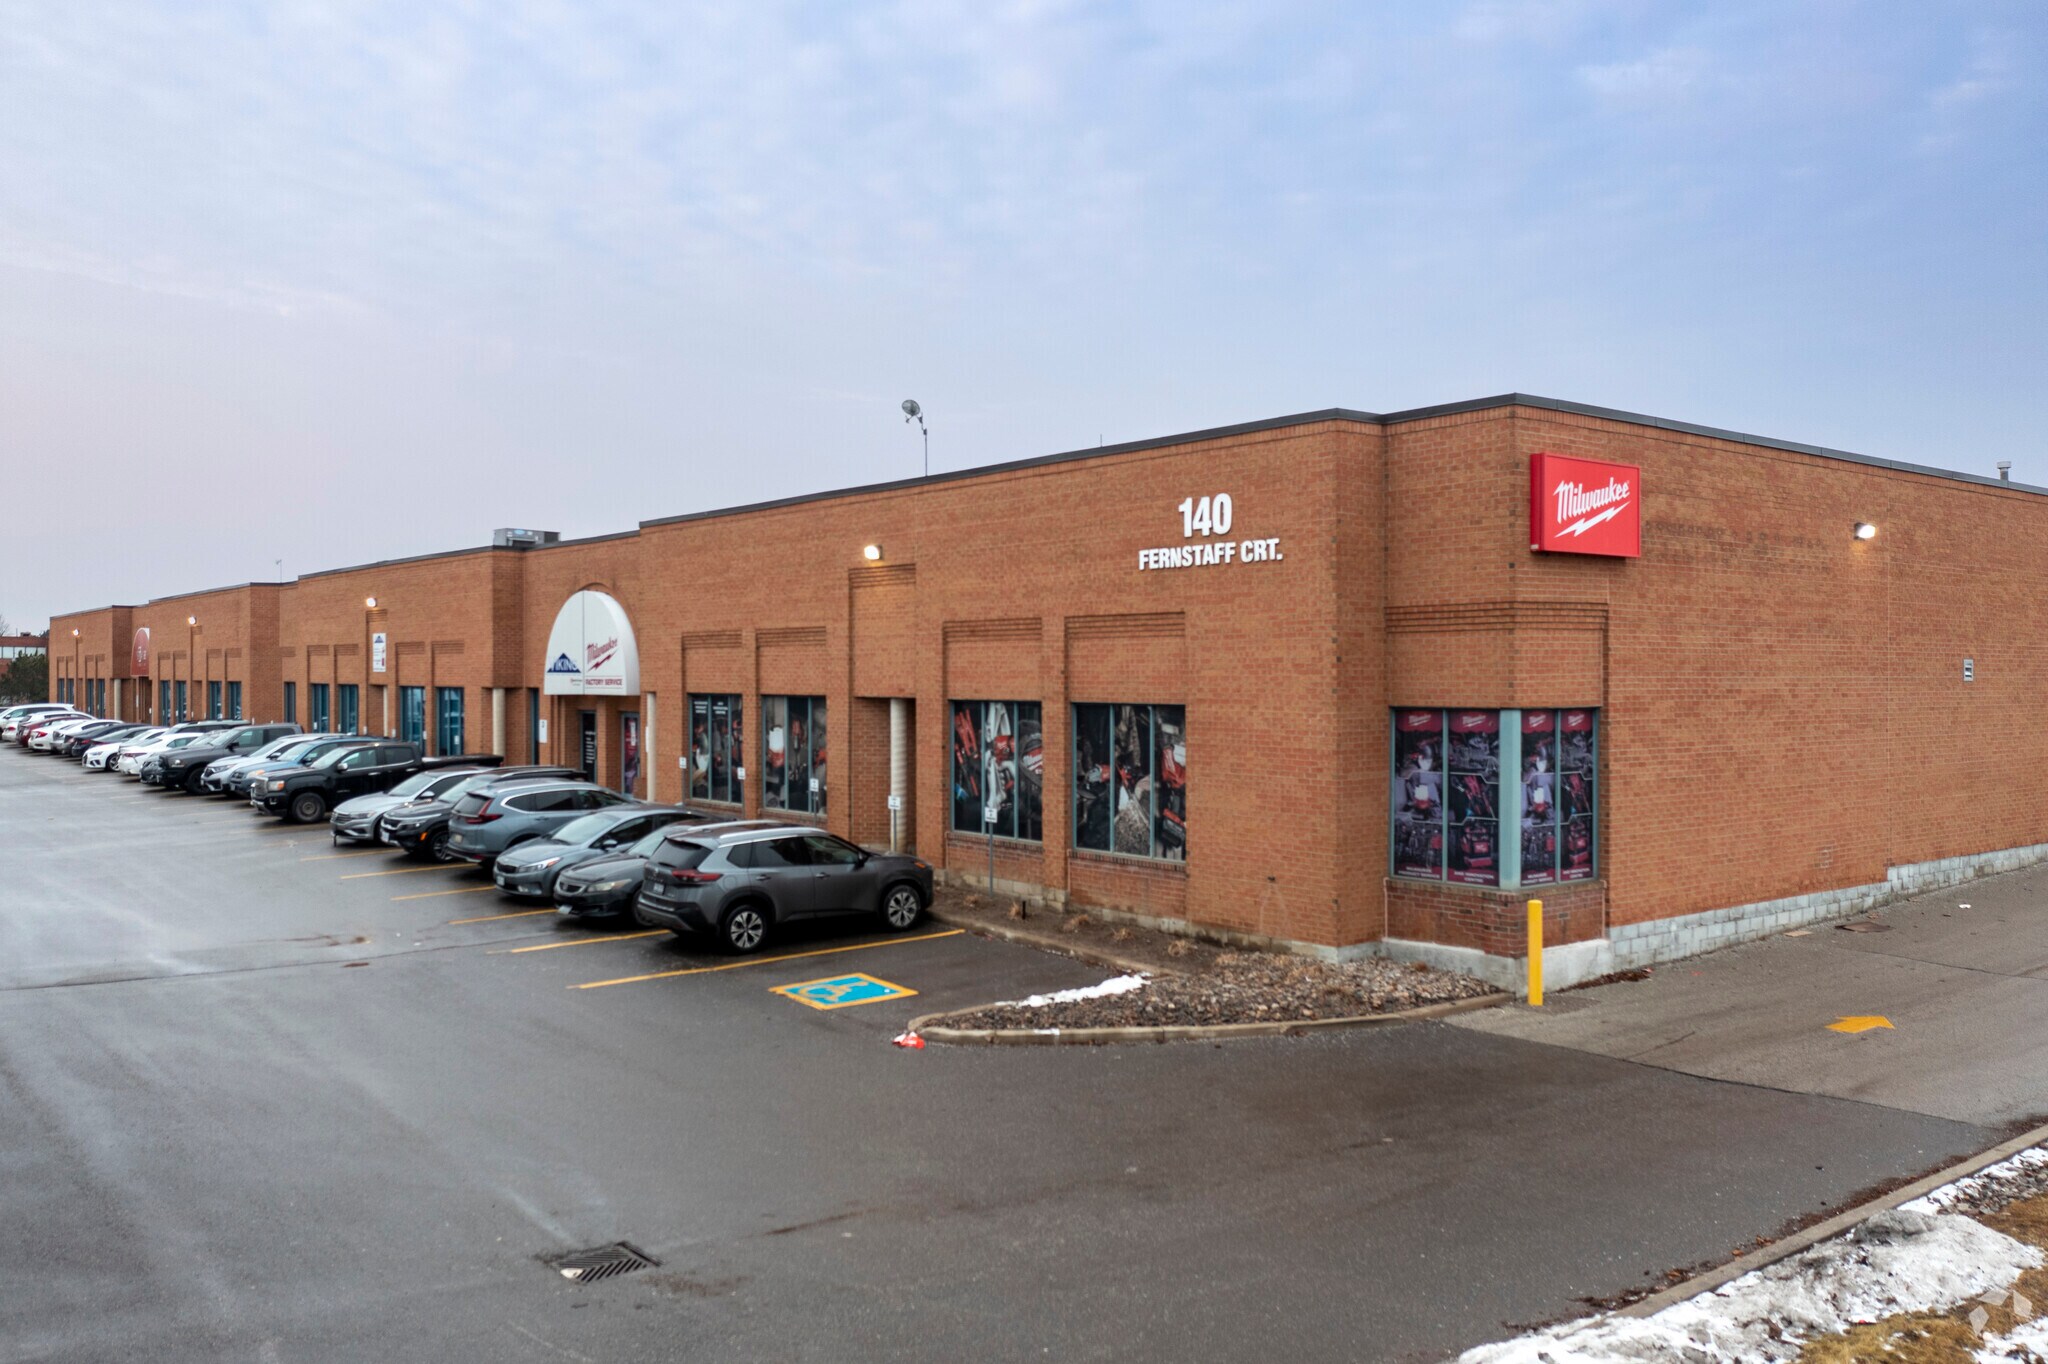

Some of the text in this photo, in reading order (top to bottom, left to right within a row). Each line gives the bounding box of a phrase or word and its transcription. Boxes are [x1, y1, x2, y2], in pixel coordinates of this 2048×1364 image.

[1178, 493, 1232, 537] 140
[1553, 477, 1630, 524] Milwaukee
[1138, 538, 1283, 571] FERNSTAFF CRT.
[586, 678, 604, 686] FACTORY
[605, 678, 622, 686] SERVICE
